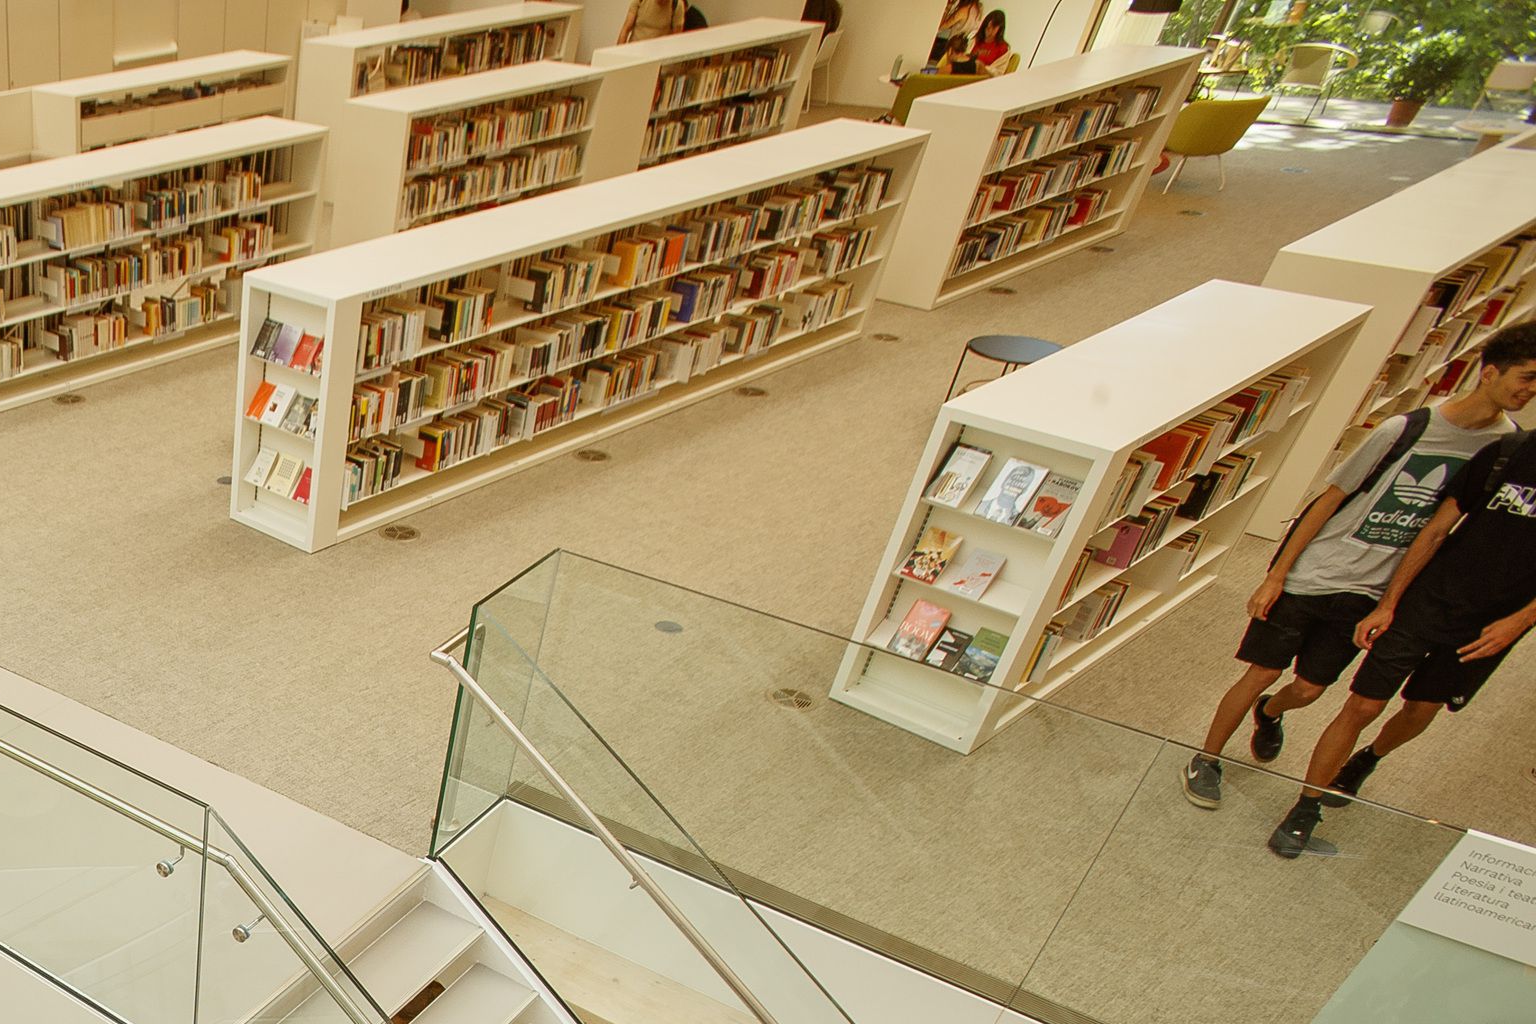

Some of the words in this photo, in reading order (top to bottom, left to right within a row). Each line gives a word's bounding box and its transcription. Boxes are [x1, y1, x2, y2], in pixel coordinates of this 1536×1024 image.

[1486, 483, 1536, 517] PU
[1368, 509, 1431, 528] adidas
[1451, 871, 1496, 891] Poesia
[1459, 860, 1523, 887] Narrativa
[1442, 881, 1510, 910] Literatura
